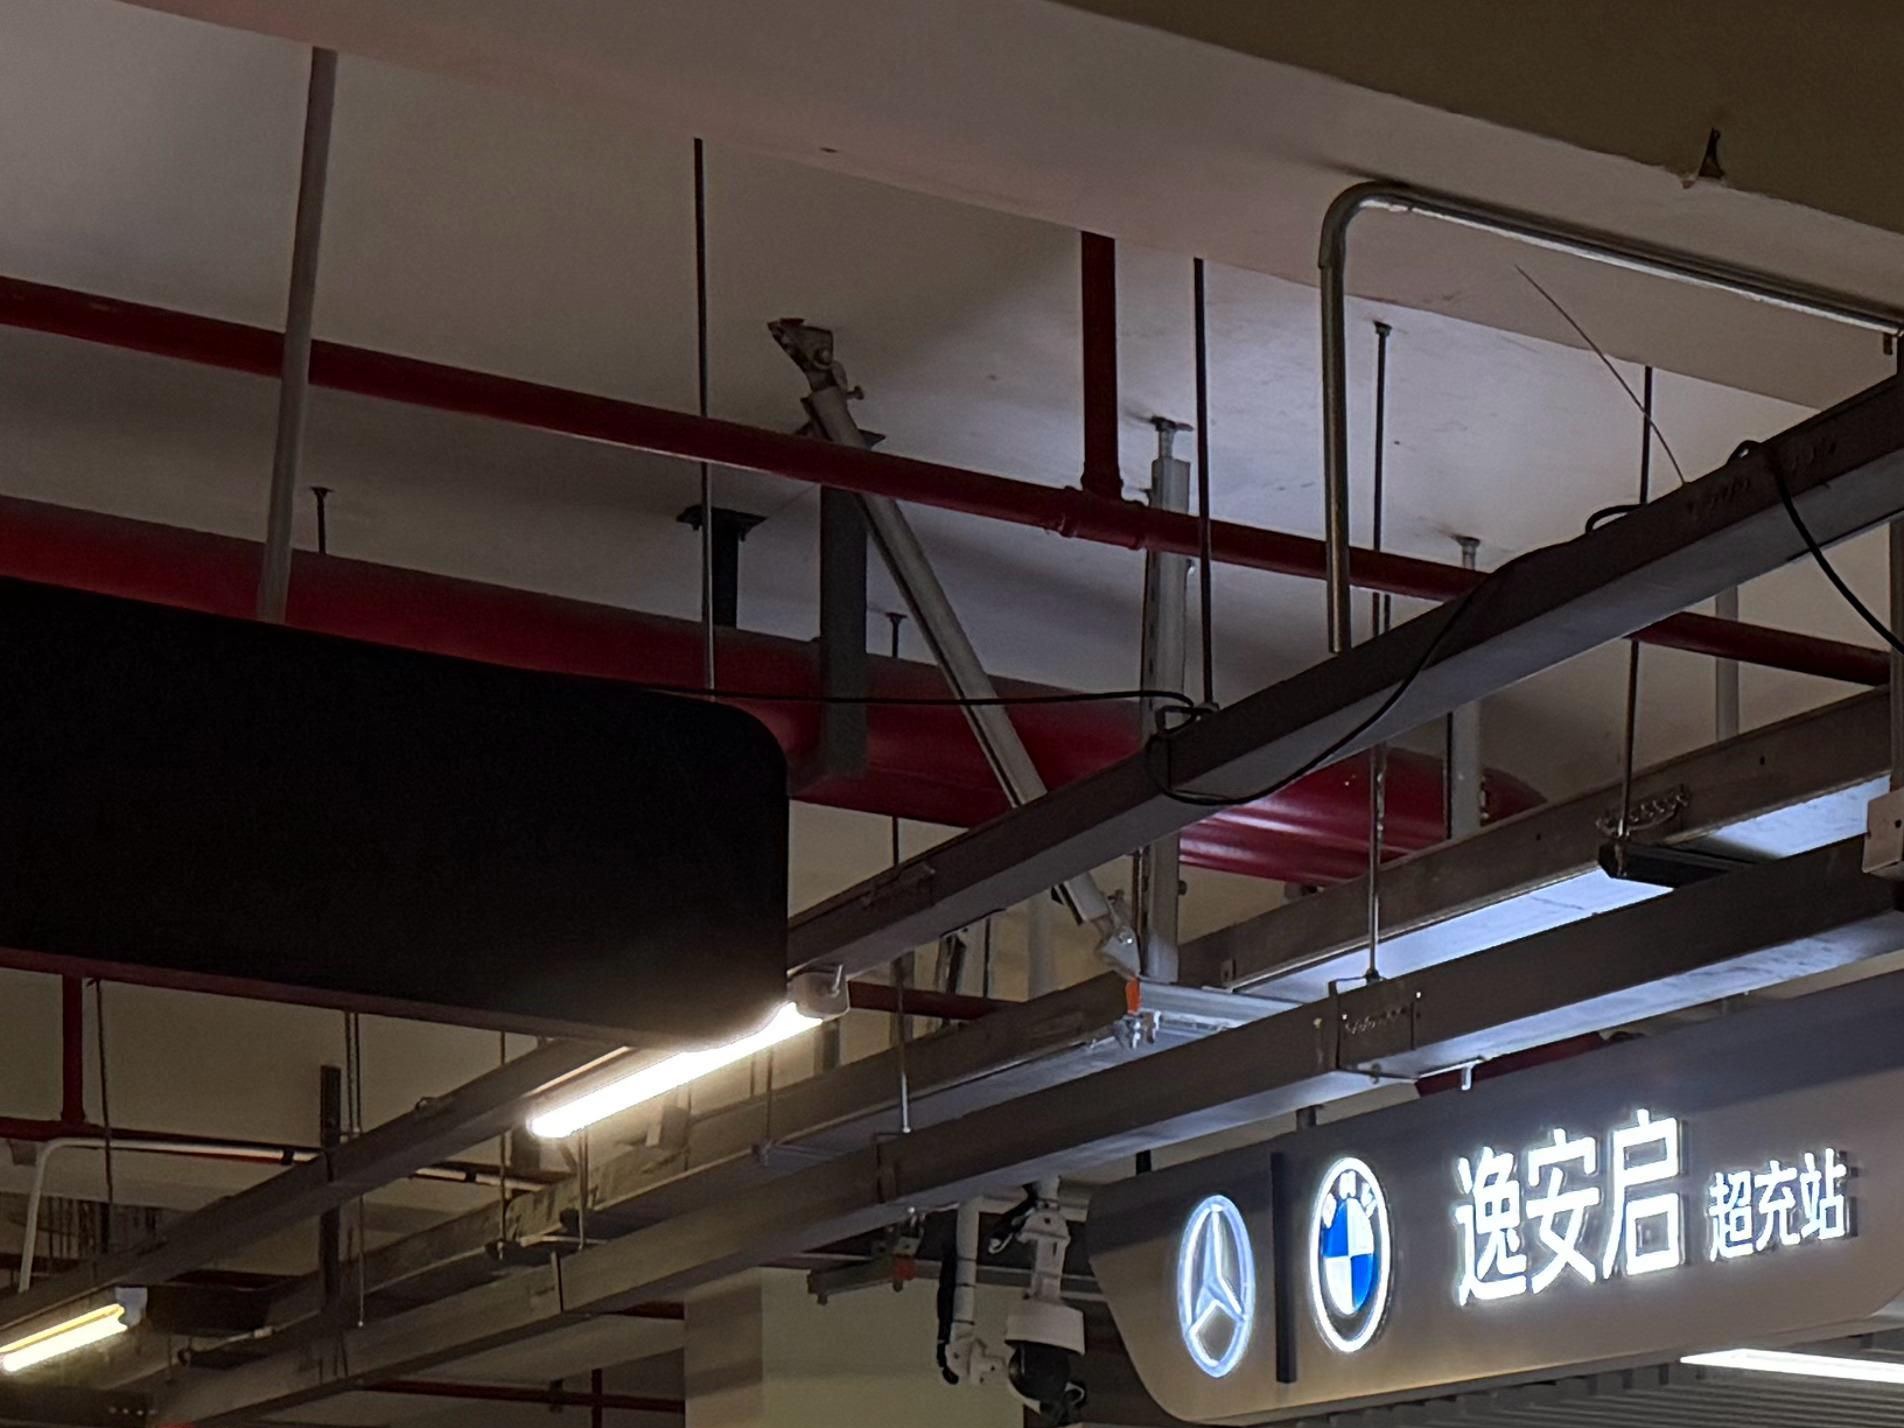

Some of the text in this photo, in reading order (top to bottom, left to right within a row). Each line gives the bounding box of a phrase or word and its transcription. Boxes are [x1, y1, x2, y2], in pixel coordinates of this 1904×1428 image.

[1455, 1109, 1850, 1308] 逸安启 超充站
